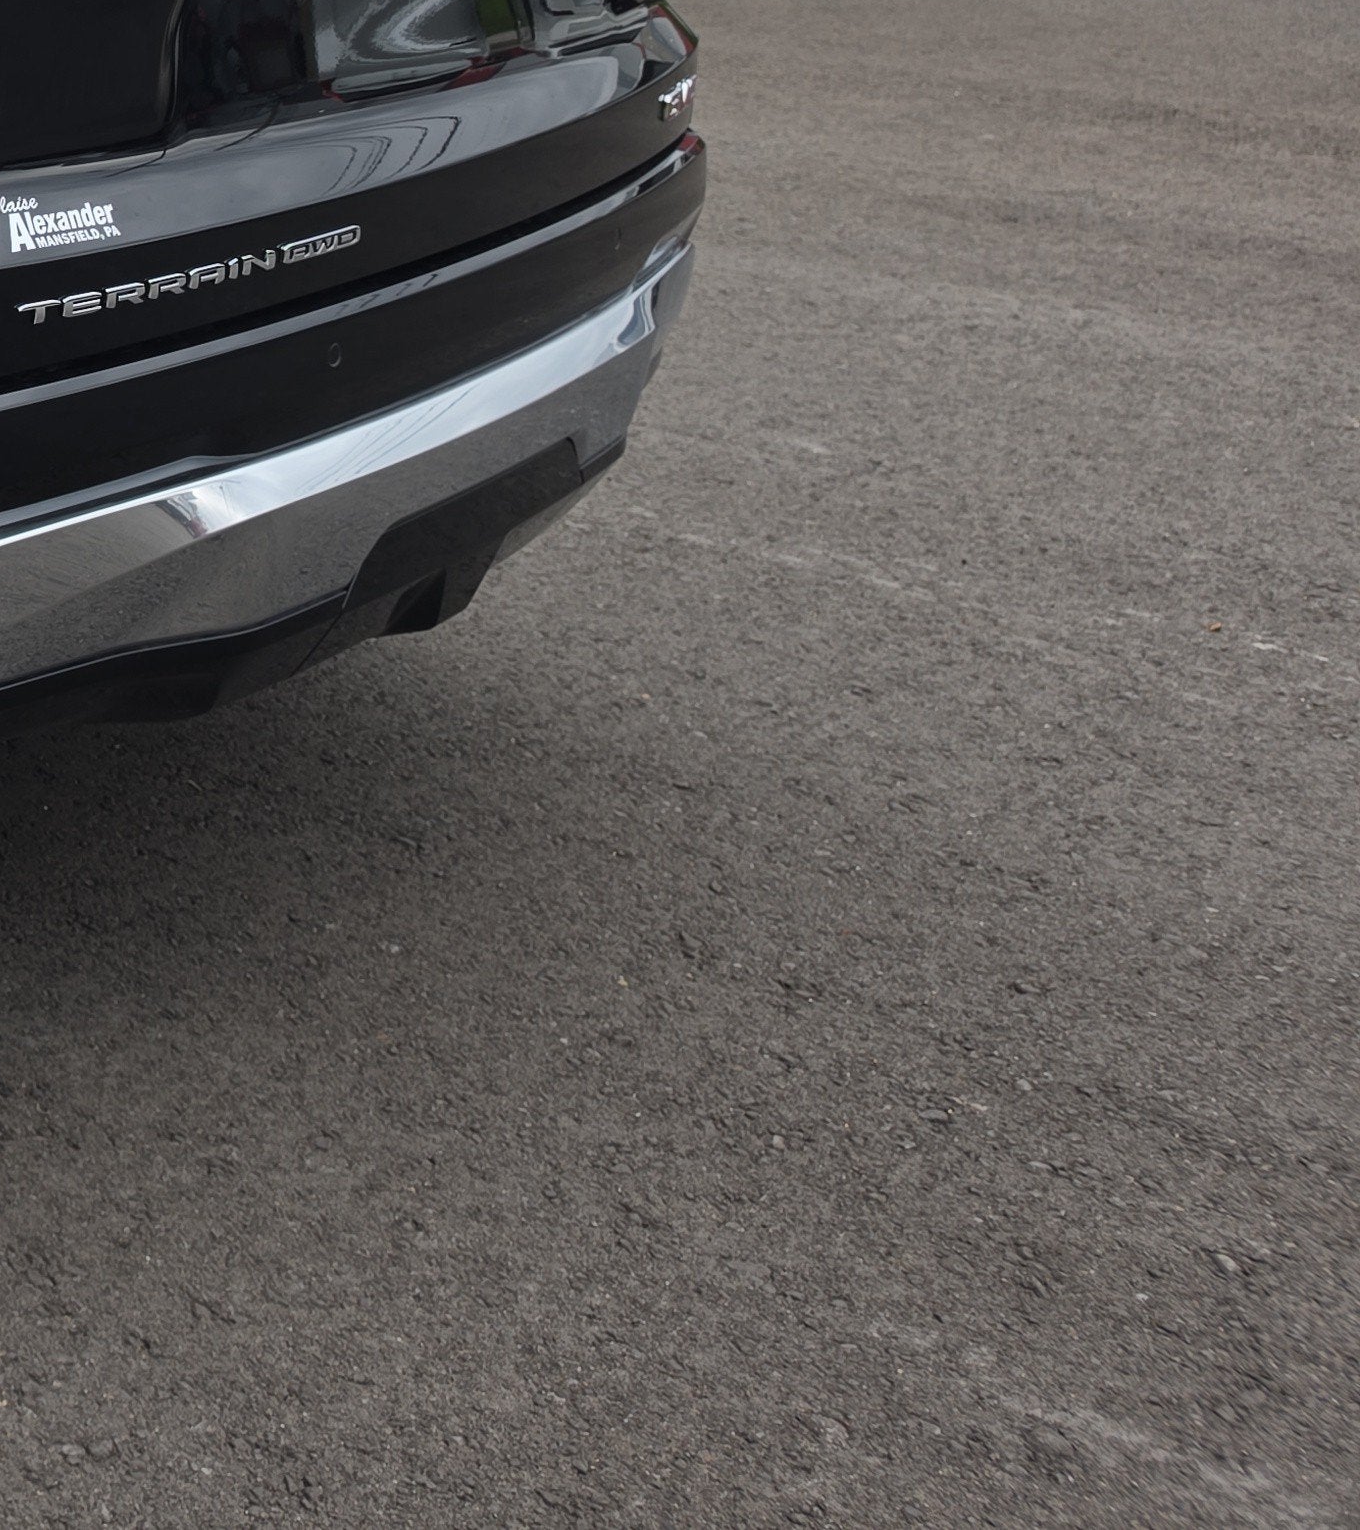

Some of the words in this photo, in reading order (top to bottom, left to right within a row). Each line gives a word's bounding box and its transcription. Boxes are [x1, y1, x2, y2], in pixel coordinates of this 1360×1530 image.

[9, 202, 114, 253] Alexander
[35, 230, 106, 249] MANSFIELD,
[105, 225, 121, 238] PA
[15, 249, 276, 325] TERRAIN
[284, 225, 361, 263] AWD
